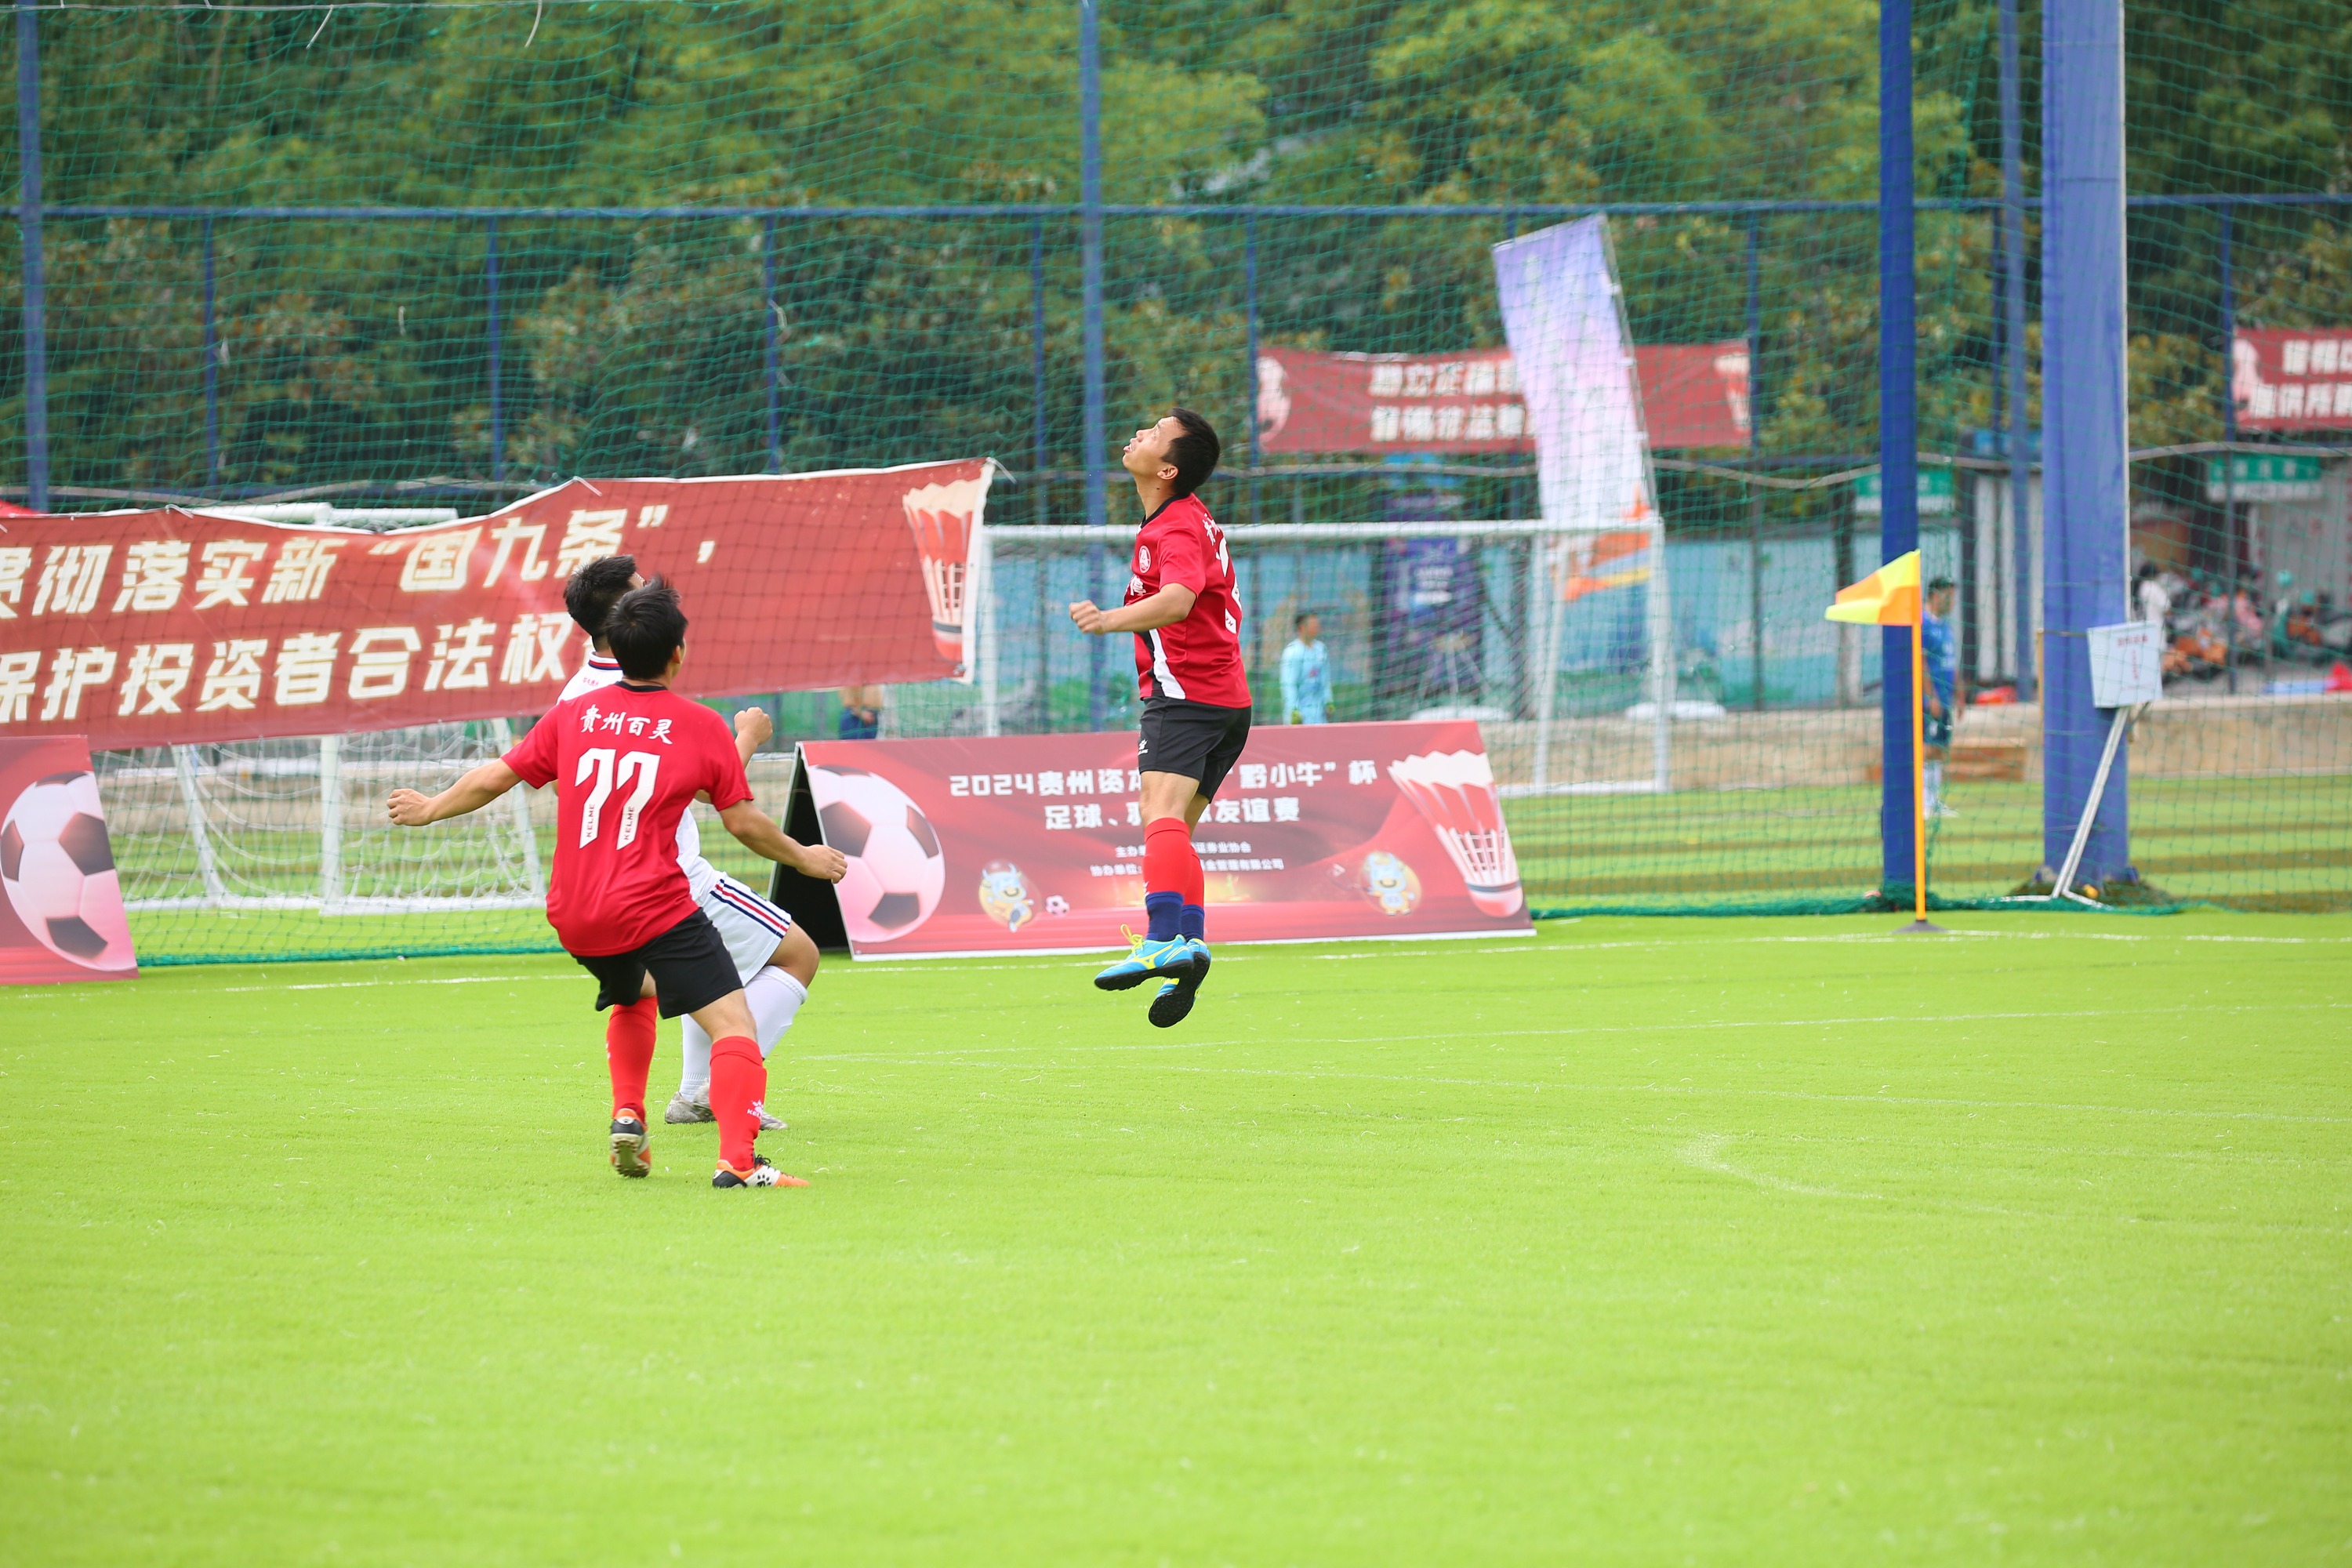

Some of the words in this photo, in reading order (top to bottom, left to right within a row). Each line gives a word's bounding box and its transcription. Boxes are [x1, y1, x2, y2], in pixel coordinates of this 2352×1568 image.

[0, 611, 594, 724] 保护投资者合法权
[580, 704, 673, 745] 贵州百灵
[575, 747, 661, 851] 77
[586, 804, 595, 838] KELME
[623, 806, 634, 840] KELME
